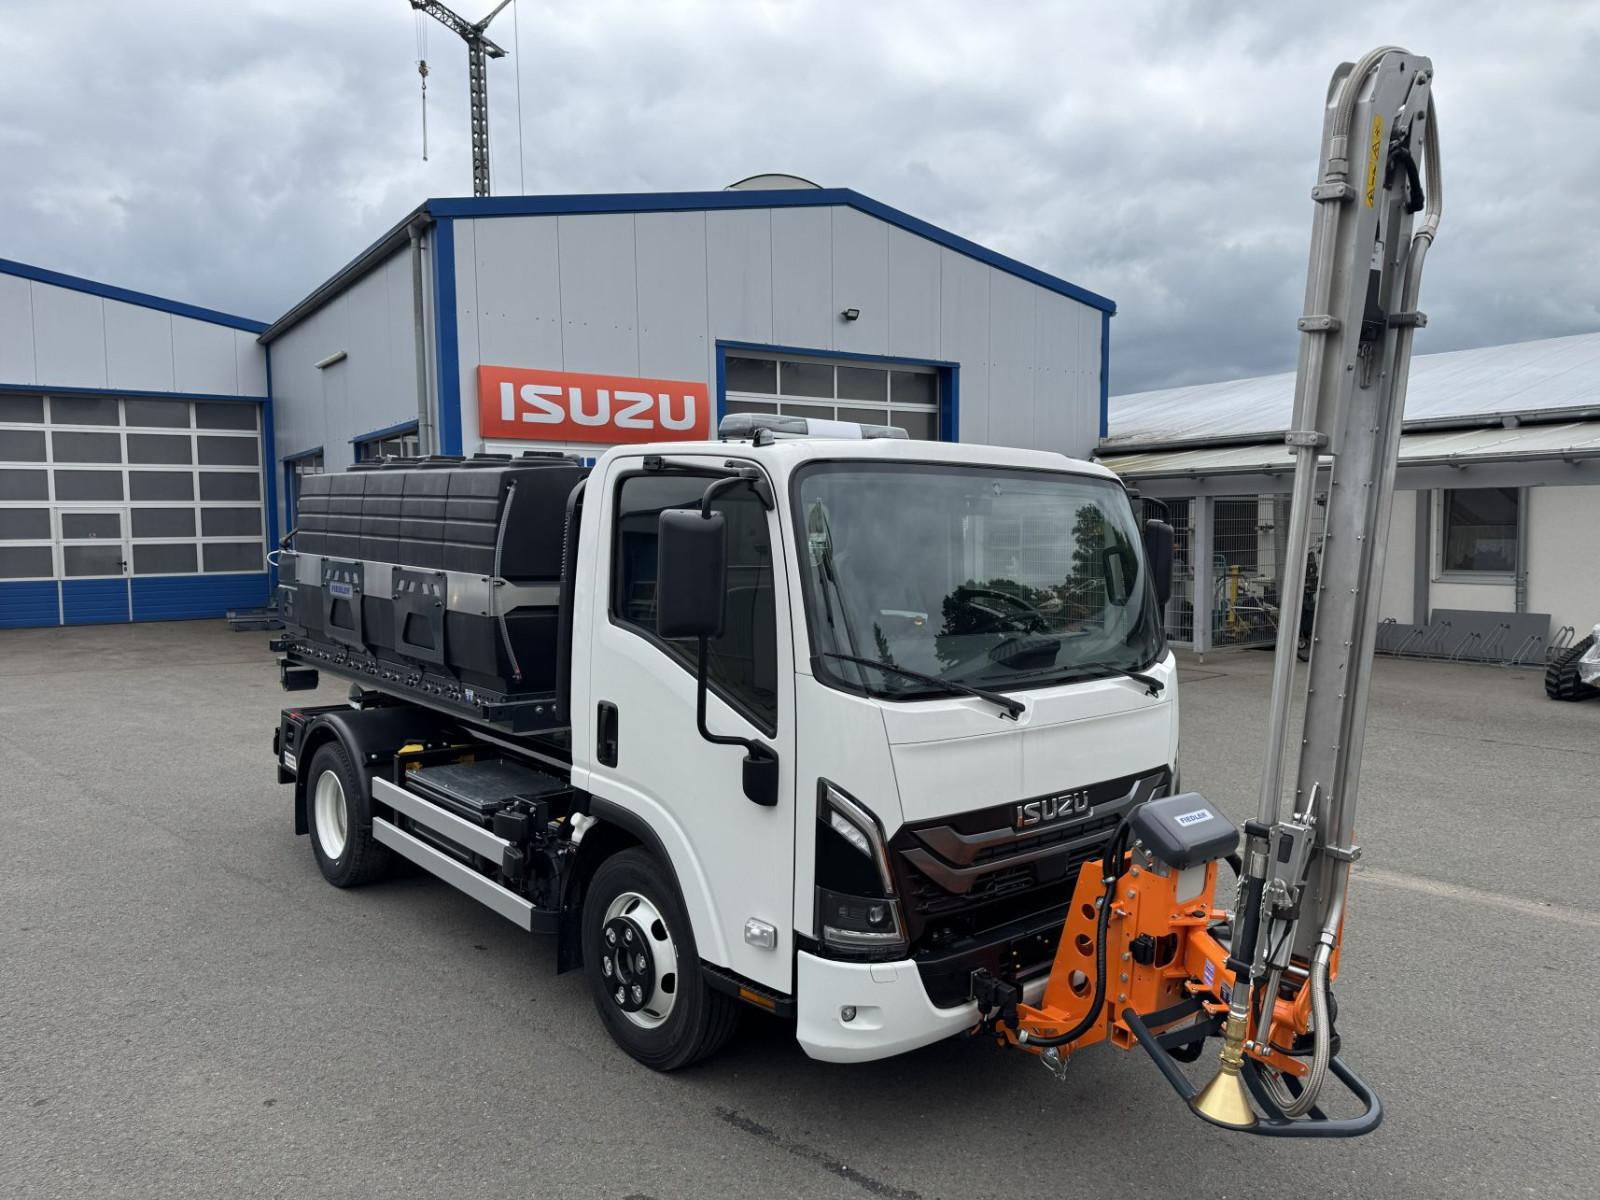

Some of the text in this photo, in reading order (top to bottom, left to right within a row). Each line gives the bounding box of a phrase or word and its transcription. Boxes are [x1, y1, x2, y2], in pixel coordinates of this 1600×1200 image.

[499, 382, 696, 431] ISUZU
[1016, 790, 1089, 828] ISUZU
[1179, 811, 1209, 824] FIEDL
